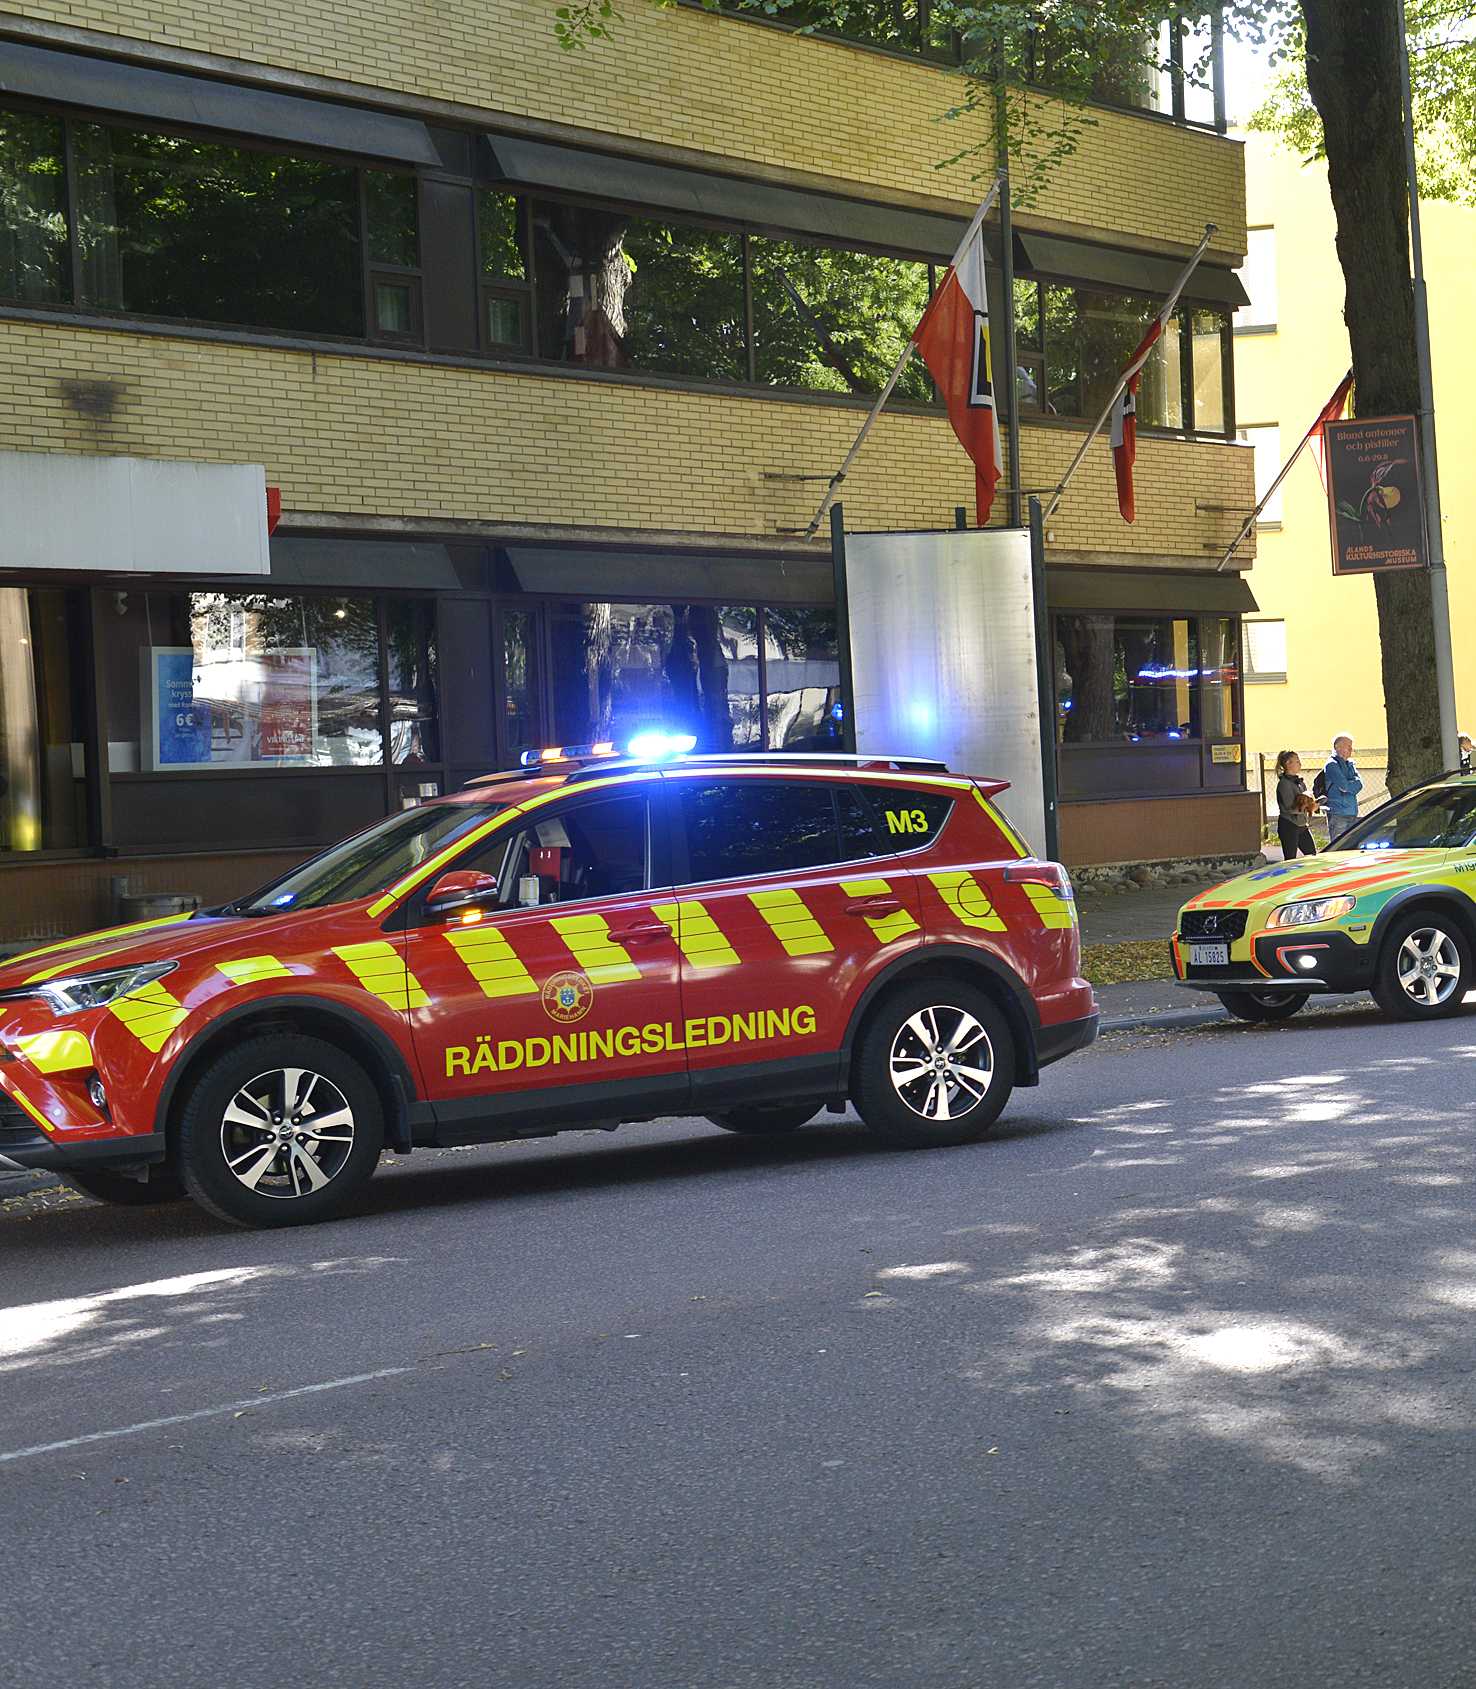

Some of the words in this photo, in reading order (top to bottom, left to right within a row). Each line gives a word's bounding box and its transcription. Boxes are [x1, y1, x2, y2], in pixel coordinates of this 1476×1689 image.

[1337, 431, 1363, 440] Bland
[1365, 428, 1407, 438] antenner
[1346, 442, 1363, 451] och
[1365, 439, 1399, 451] pistiller
[1346, 549, 1417, 561] KULTURHISTORISKA
[1385, 556, 1417, 564] MUSEUM
[885, 810, 929, 833] M3
[1205, 951, 1224, 963] 15825
[551, 1006, 586, 1020] MARIEHAMN
[445, 1005, 817, 1077] RÄDDNINGSLEDNING
